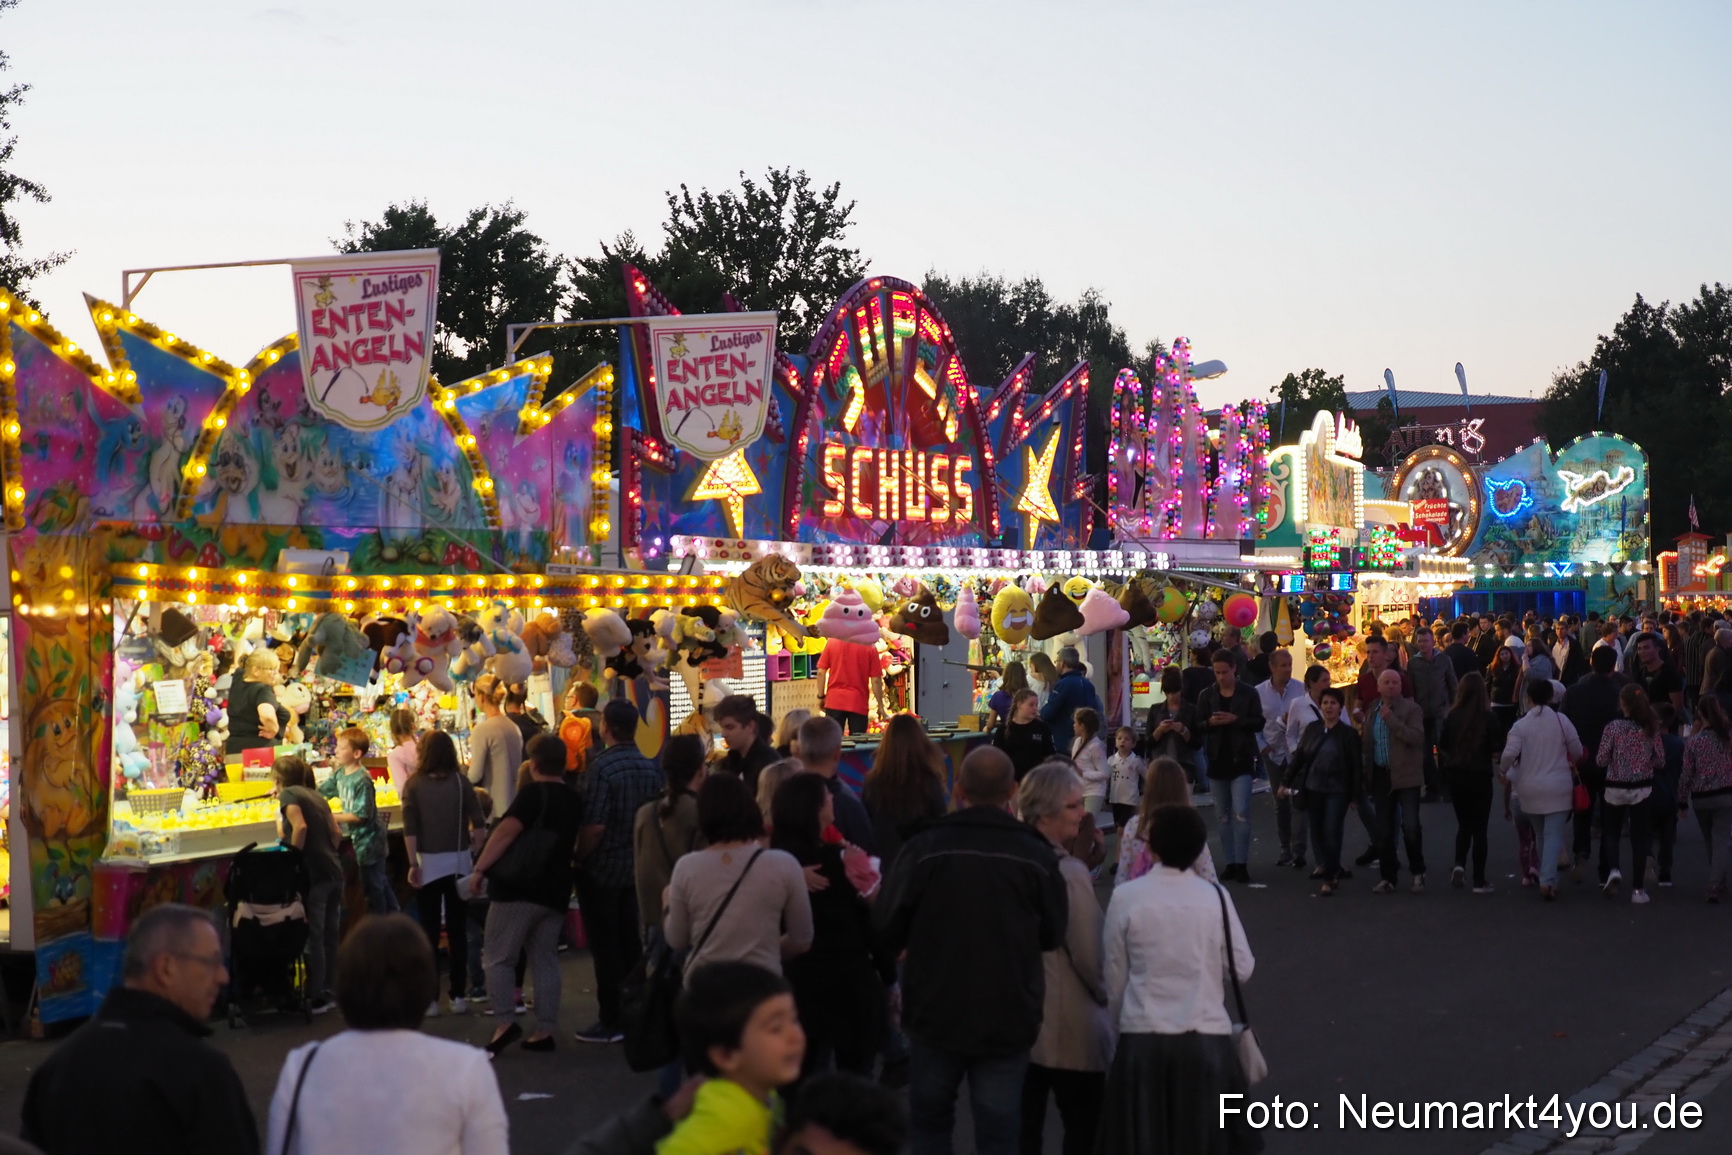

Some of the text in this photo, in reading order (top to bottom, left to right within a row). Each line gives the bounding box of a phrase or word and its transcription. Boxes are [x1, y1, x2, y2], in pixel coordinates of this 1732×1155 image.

[361, 272, 423, 299] Lustiges
[312, 299, 416, 338] ENTEN-
[310, 331, 425, 376] ANGELN
[710, 330, 763, 352] Lustiges
[666, 353, 757, 384] ENTEN-
[664, 378, 763, 412] ANGELN
[823, 442, 973, 524] SCHUSS
[1415, 511, 1448, 519] Schokolade
[1489, 578, 1503, 588] der
[1506, 577, 1553, 588] verlorenen
[1555, 576, 1580, 588] Stadt
